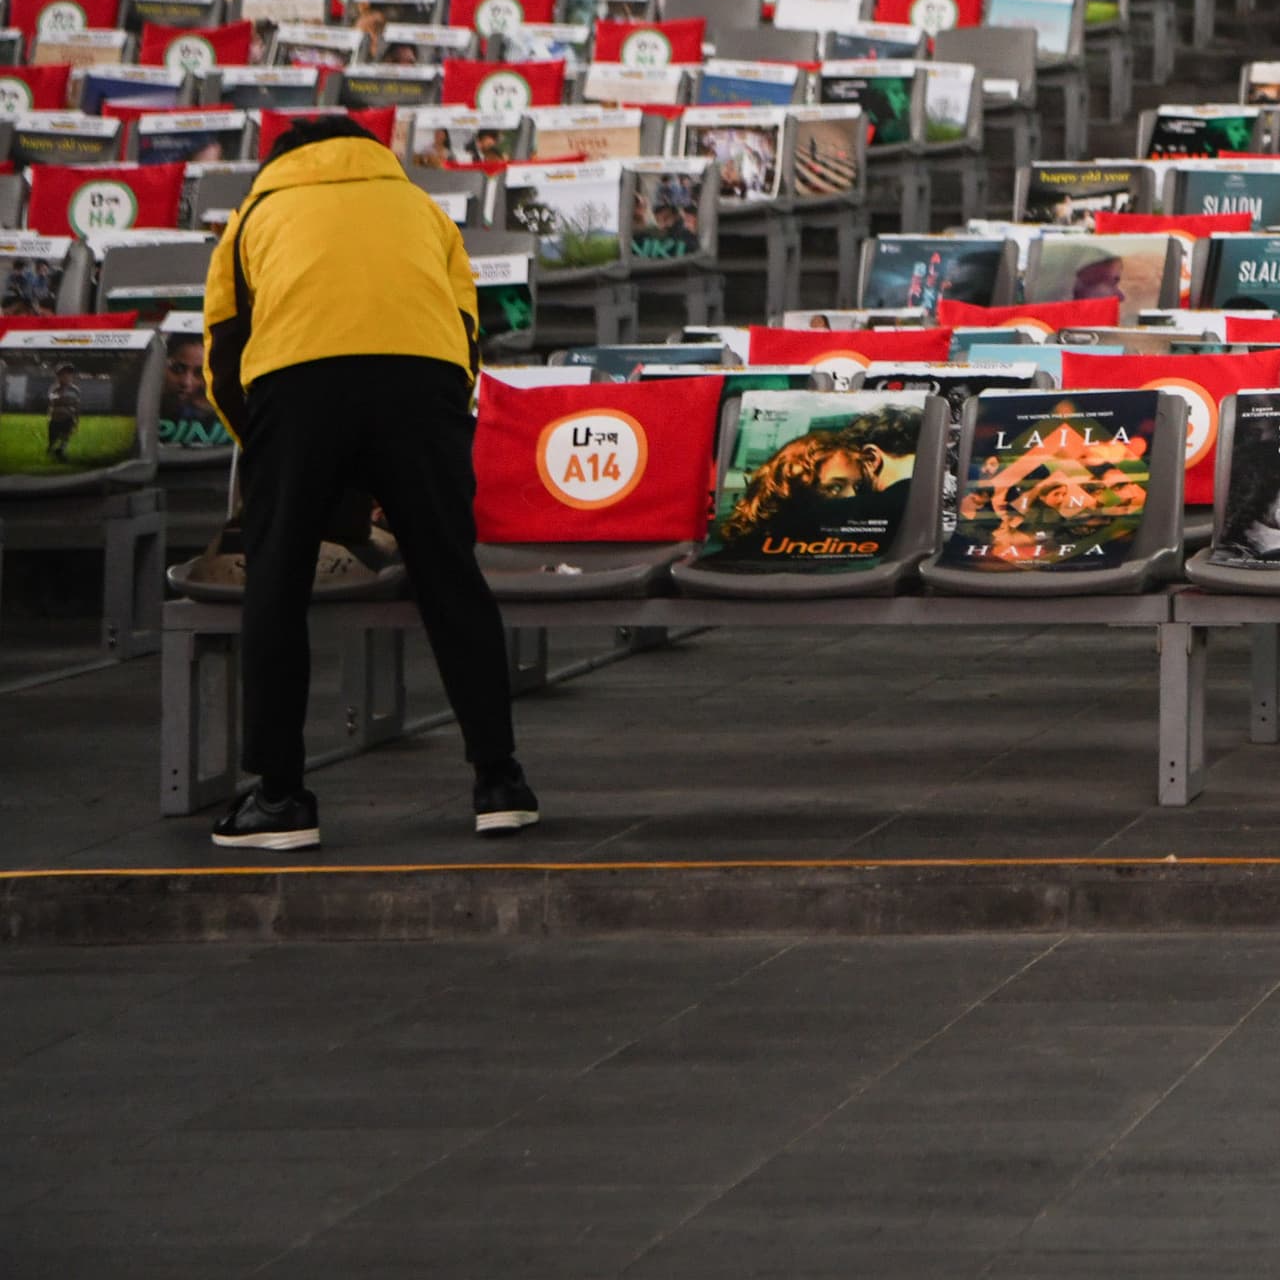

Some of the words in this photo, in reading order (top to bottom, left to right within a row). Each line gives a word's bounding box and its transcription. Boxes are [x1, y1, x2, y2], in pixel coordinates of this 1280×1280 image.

[1040, 170, 1078, 184] happy
[1080, 170, 1102, 183] old
[1103, 172, 1130, 183] year
[1203, 194, 1263, 216] SLALOM
[573, 426, 619, 448] 나구역
[995, 425, 1132, 450] LAILA
[562, 451, 621, 483] A14
[762, 536, 880, 555] Undine
[965, 543, 1105, 557] HAIFA
